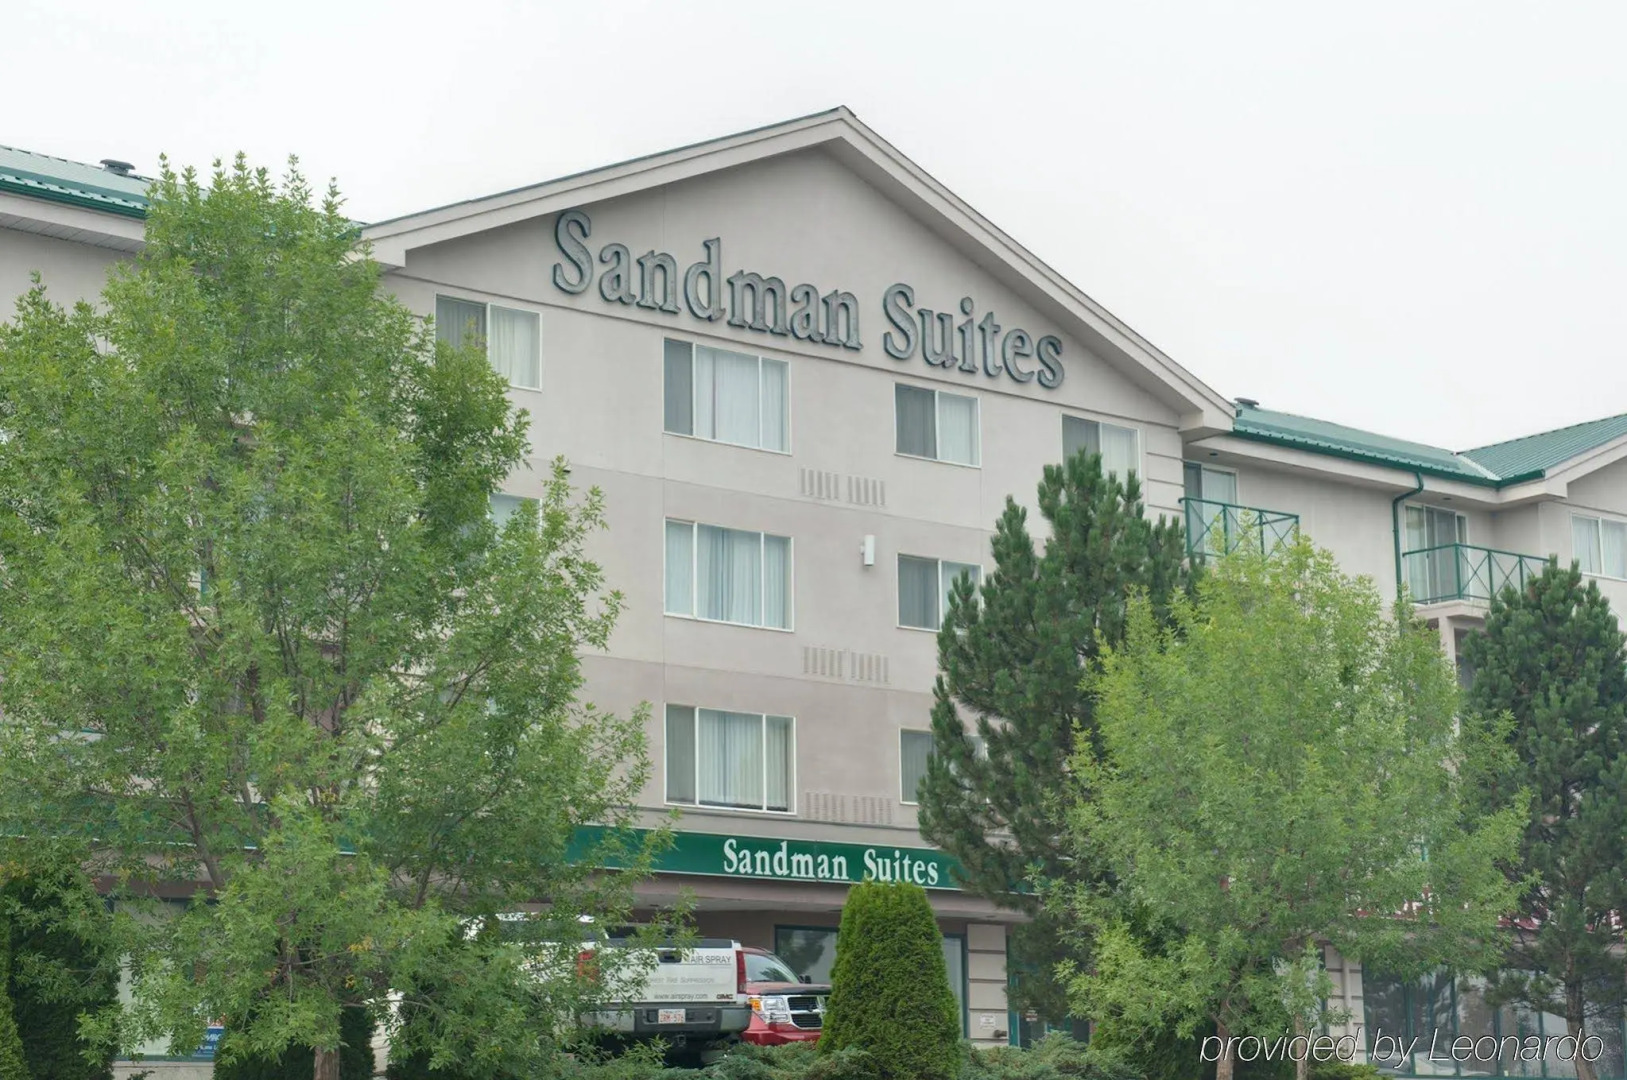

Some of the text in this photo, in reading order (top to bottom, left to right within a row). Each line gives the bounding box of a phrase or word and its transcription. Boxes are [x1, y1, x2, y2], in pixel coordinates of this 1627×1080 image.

[553, 210, 1065, 389] Sandman Suites
[723, 838, 939, 885] Sandman Suites
[705, 956, 731, 964] SPRAY
